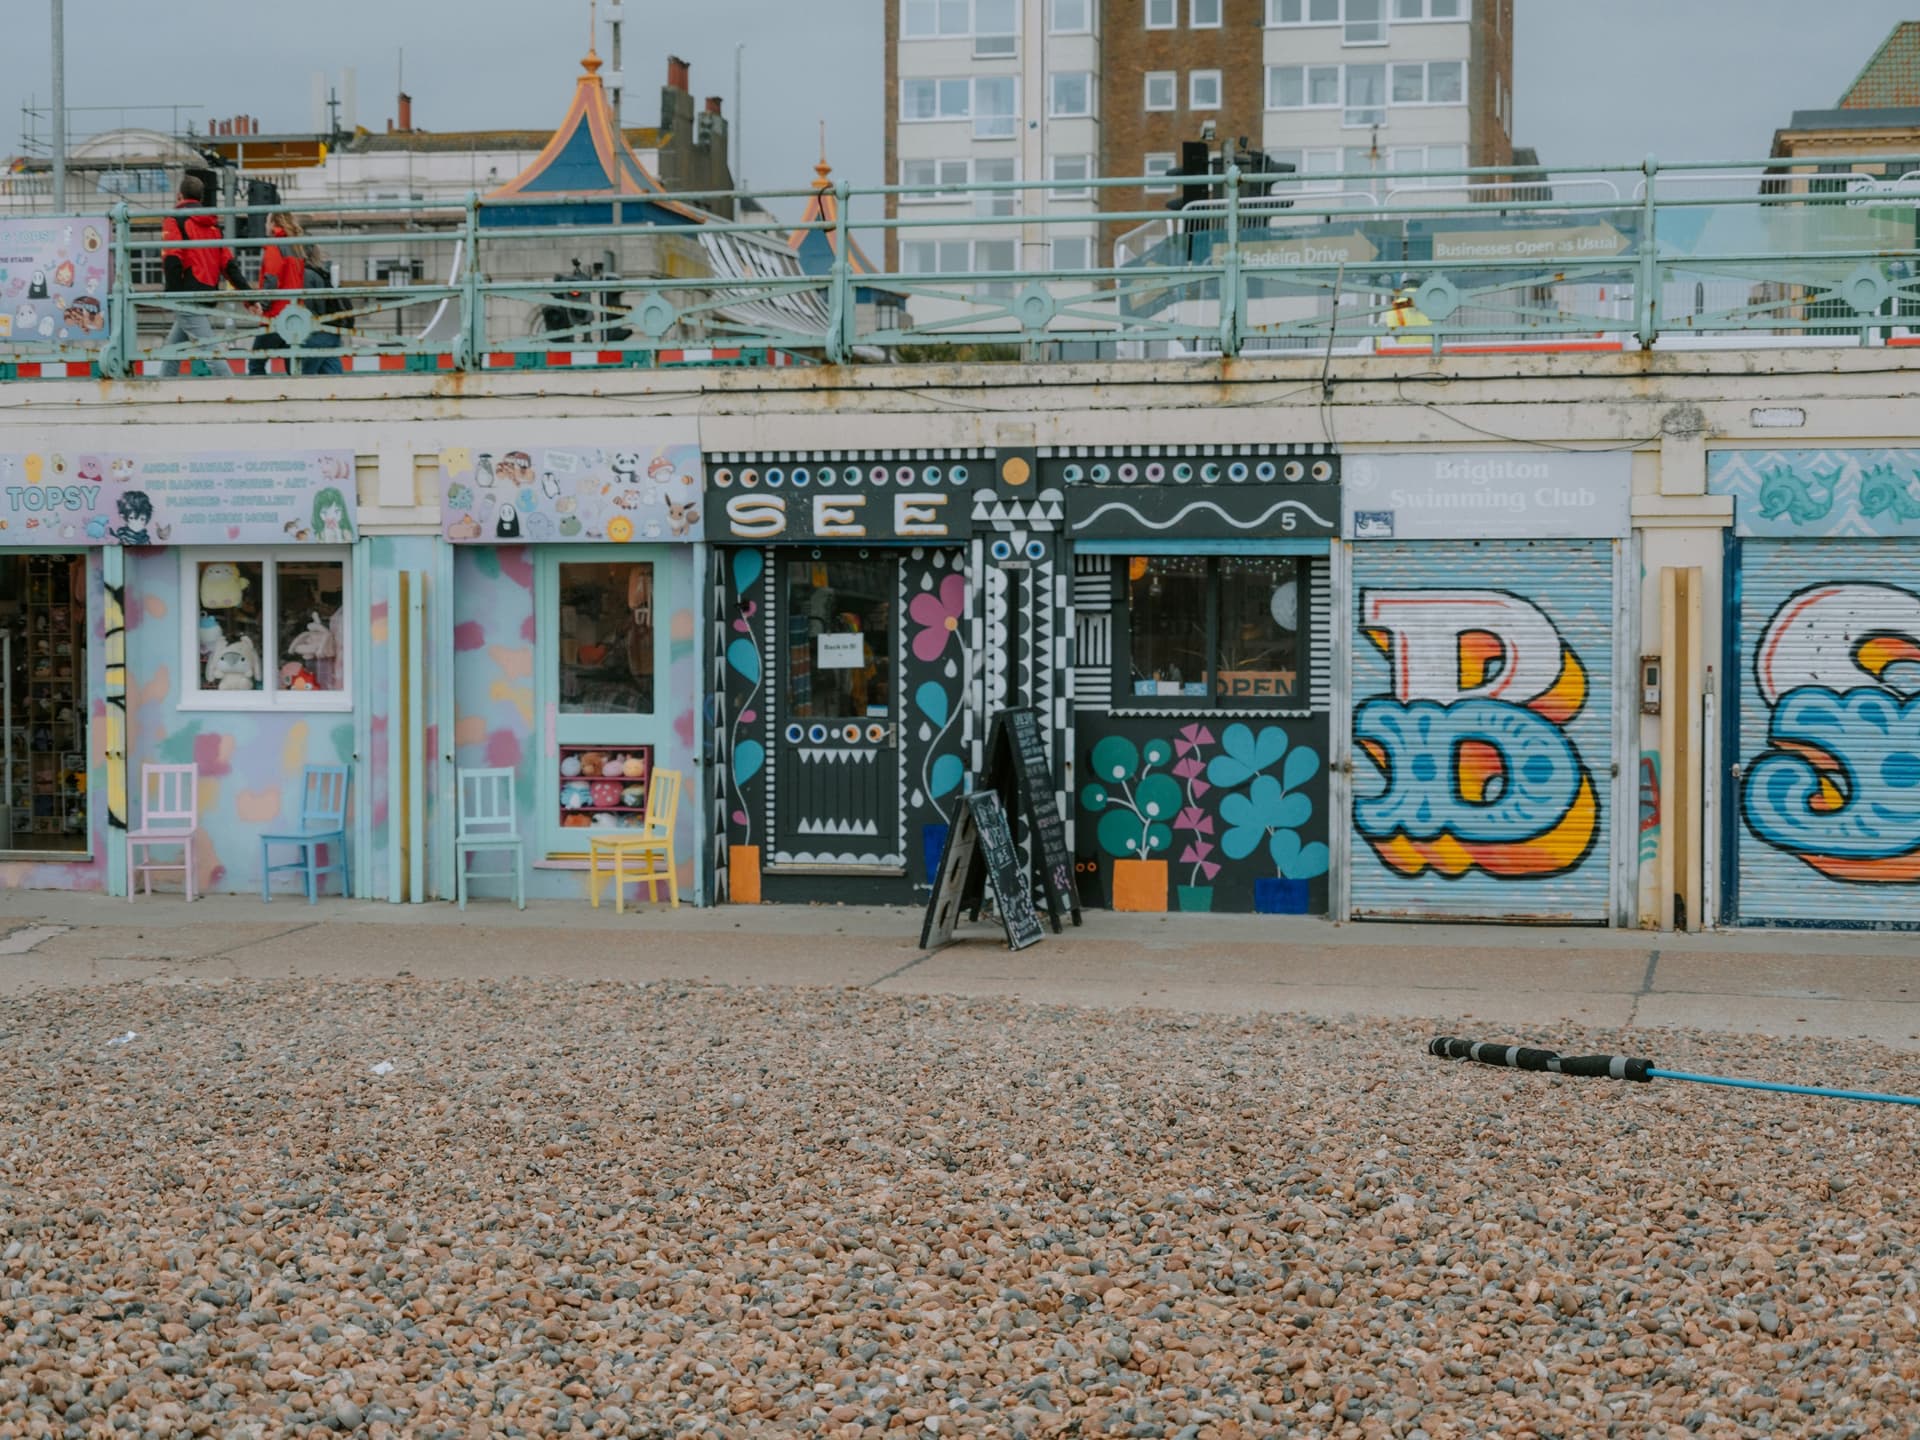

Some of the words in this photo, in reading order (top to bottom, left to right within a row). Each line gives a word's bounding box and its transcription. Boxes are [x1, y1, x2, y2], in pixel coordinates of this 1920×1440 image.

[1304, 245, 1348, 264] Drive
[1437, 243, 1512, 257] Businesses
[1515, 240, 1554, 255] Open
[1558, 242, 1574, 252] as
[1577, 235, 1617, 250] Usual
[1435, 459, 1549, 484] Brighton
[6, 485, 101, 512] TOPSY
[1390, 487, 1527, 512] Swimming
[1535, 487, 1596, 507] Club
[726, 493, 948, 538] SEE
[1281, 512, 1297, 531] 5
